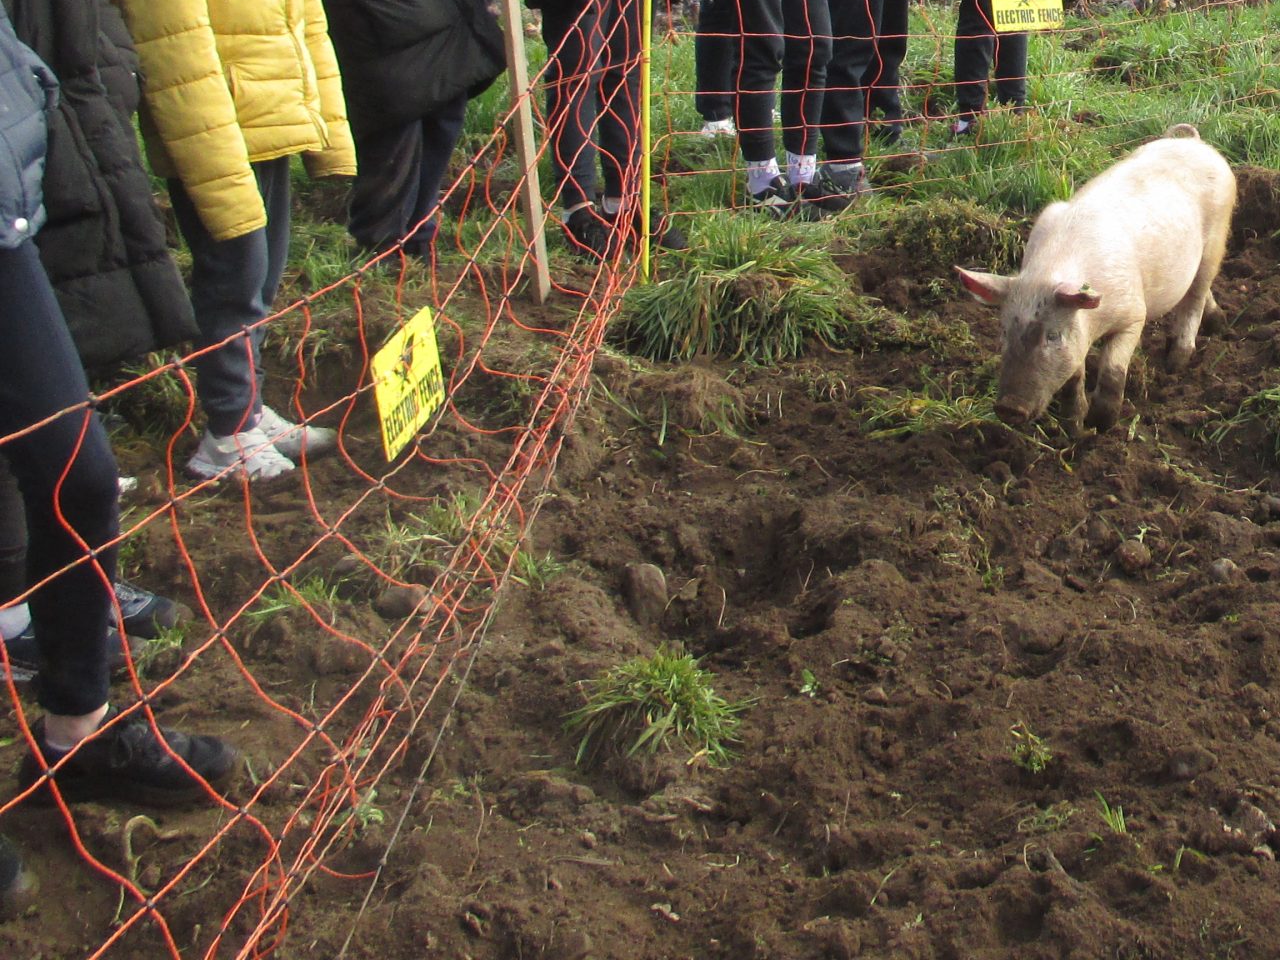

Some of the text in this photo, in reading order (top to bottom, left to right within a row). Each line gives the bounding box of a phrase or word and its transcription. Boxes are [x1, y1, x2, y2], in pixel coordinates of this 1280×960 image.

[996, 8, 1063, 25] ELECTRIC FENCE
[384, 364, 442, 445] ELECTRIC FENCE
